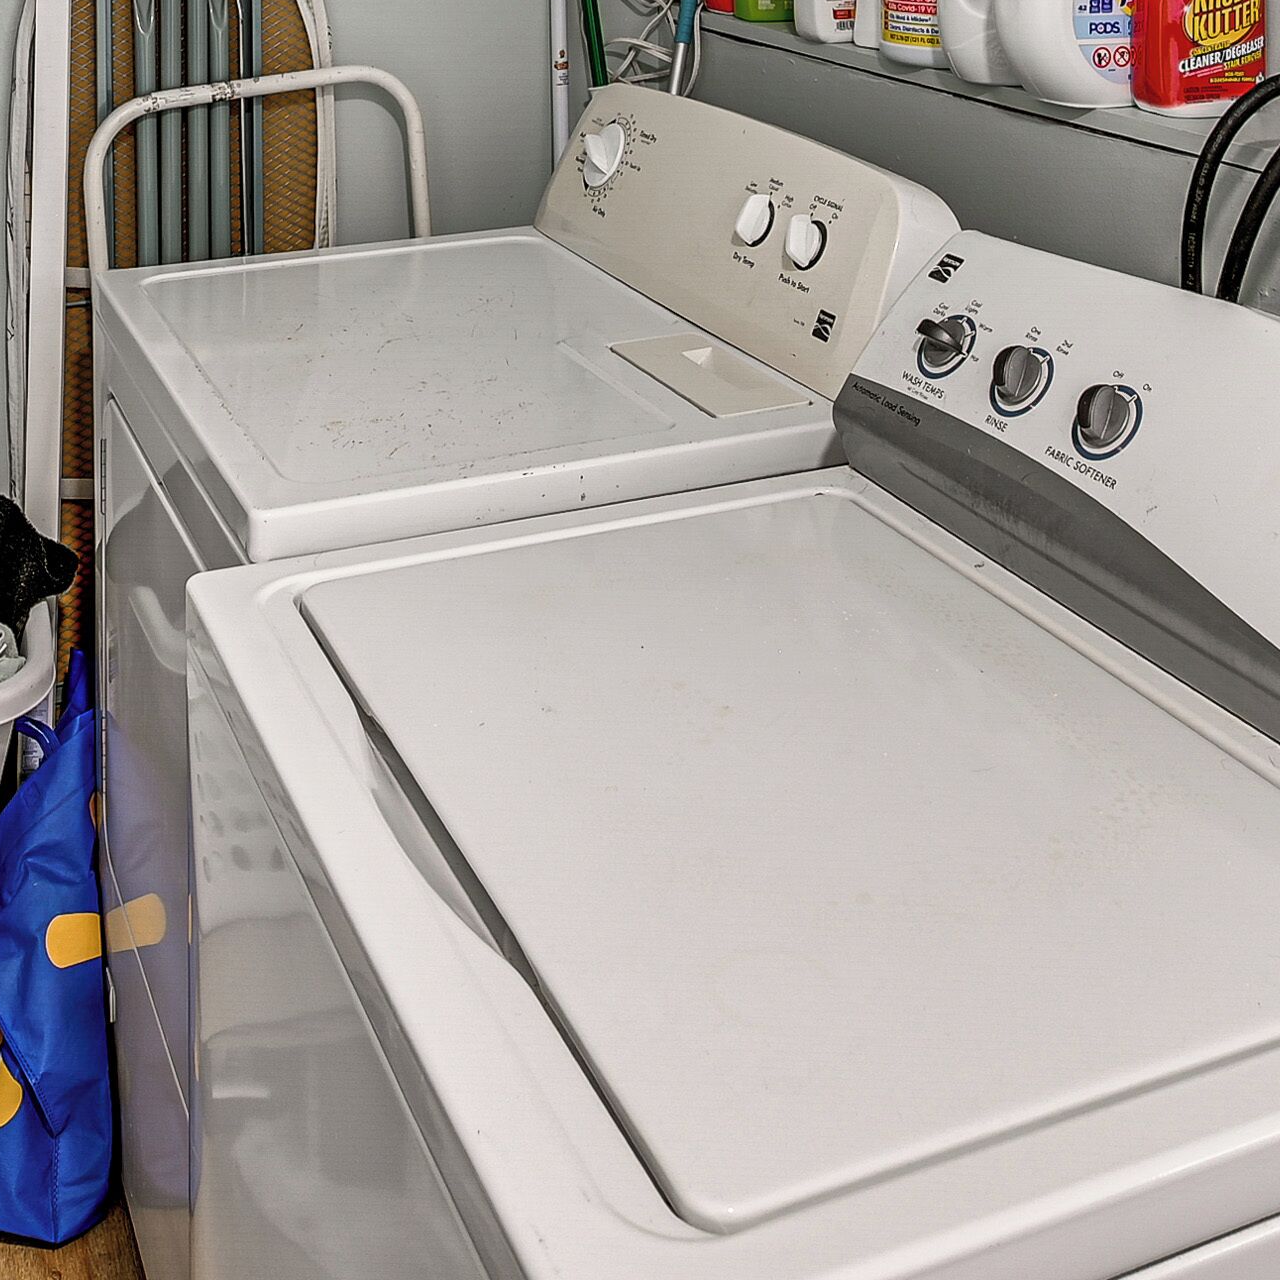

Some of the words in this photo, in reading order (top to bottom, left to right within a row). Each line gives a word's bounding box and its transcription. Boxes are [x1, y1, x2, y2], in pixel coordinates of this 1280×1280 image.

[1178, 35, 1265, 73] CLEANER/DEGREASER
[901, 370, 923, 388] WASH
[852, 381, 882, 404] Automatic
[881, 394, 898, 412] Load
[896, 404, 921, 428] Sensing
[984, 414, 1009, 433] RINSE
[1044, 445, 1074, 468] FABRIC
[1073, 461, 1118, 490] SOFTENER
